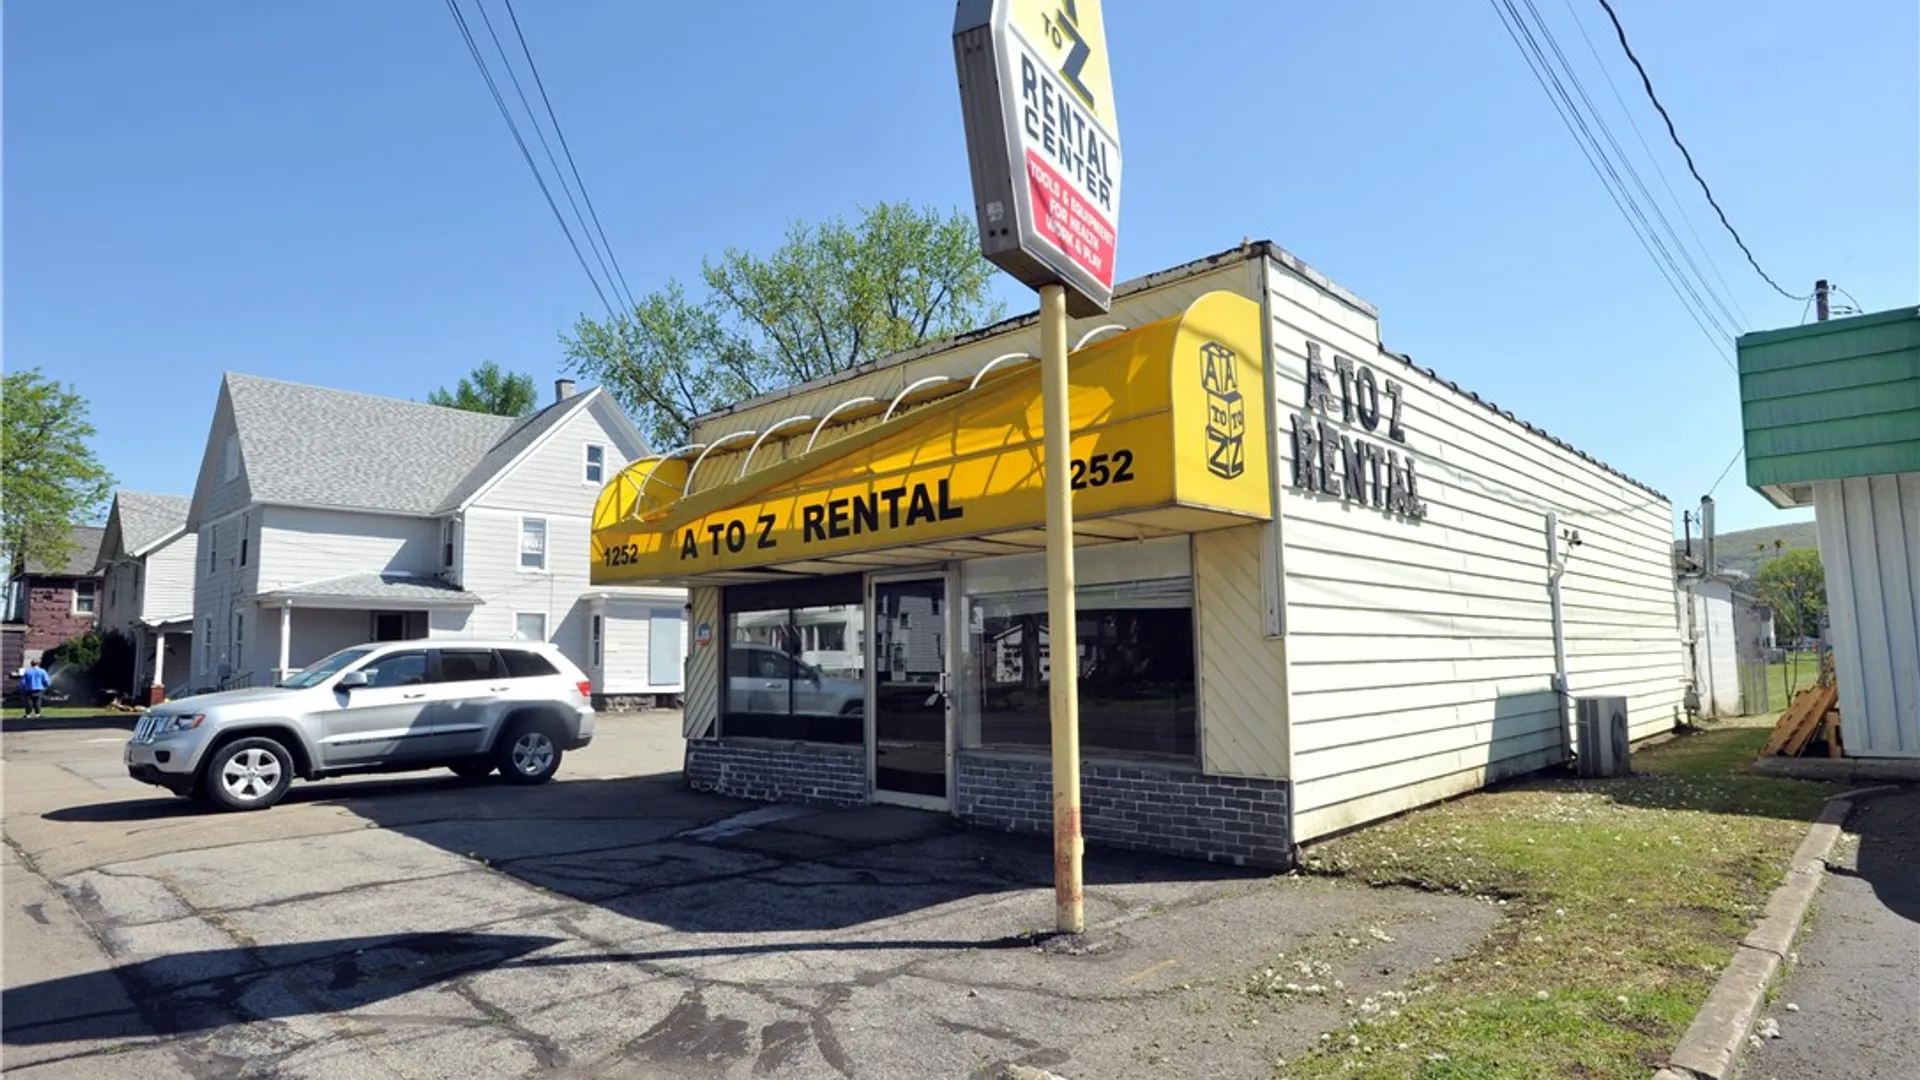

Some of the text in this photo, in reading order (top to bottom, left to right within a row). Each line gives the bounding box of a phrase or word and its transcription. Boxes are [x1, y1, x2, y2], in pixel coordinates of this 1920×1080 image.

[1042, 12, 1062, 50] TO
[1056, 8, 1094, 110] Z
[1022, 52, 1113, 188] RENTAL
[1025, 104, 1111, 212] CENTER
[1030, 160, 1060, 198] TOOLS
[1050, 197, 1068, 224] FOR
[1306, 341, 1406, 443] A TO Z
[1071, 450, 1135, 490] 252
[1291, 413, 1426, 520] RENTAL
[604, 544, 639, 567] 1252
[681, 479, 963, 560] A TO Z RENTAL
